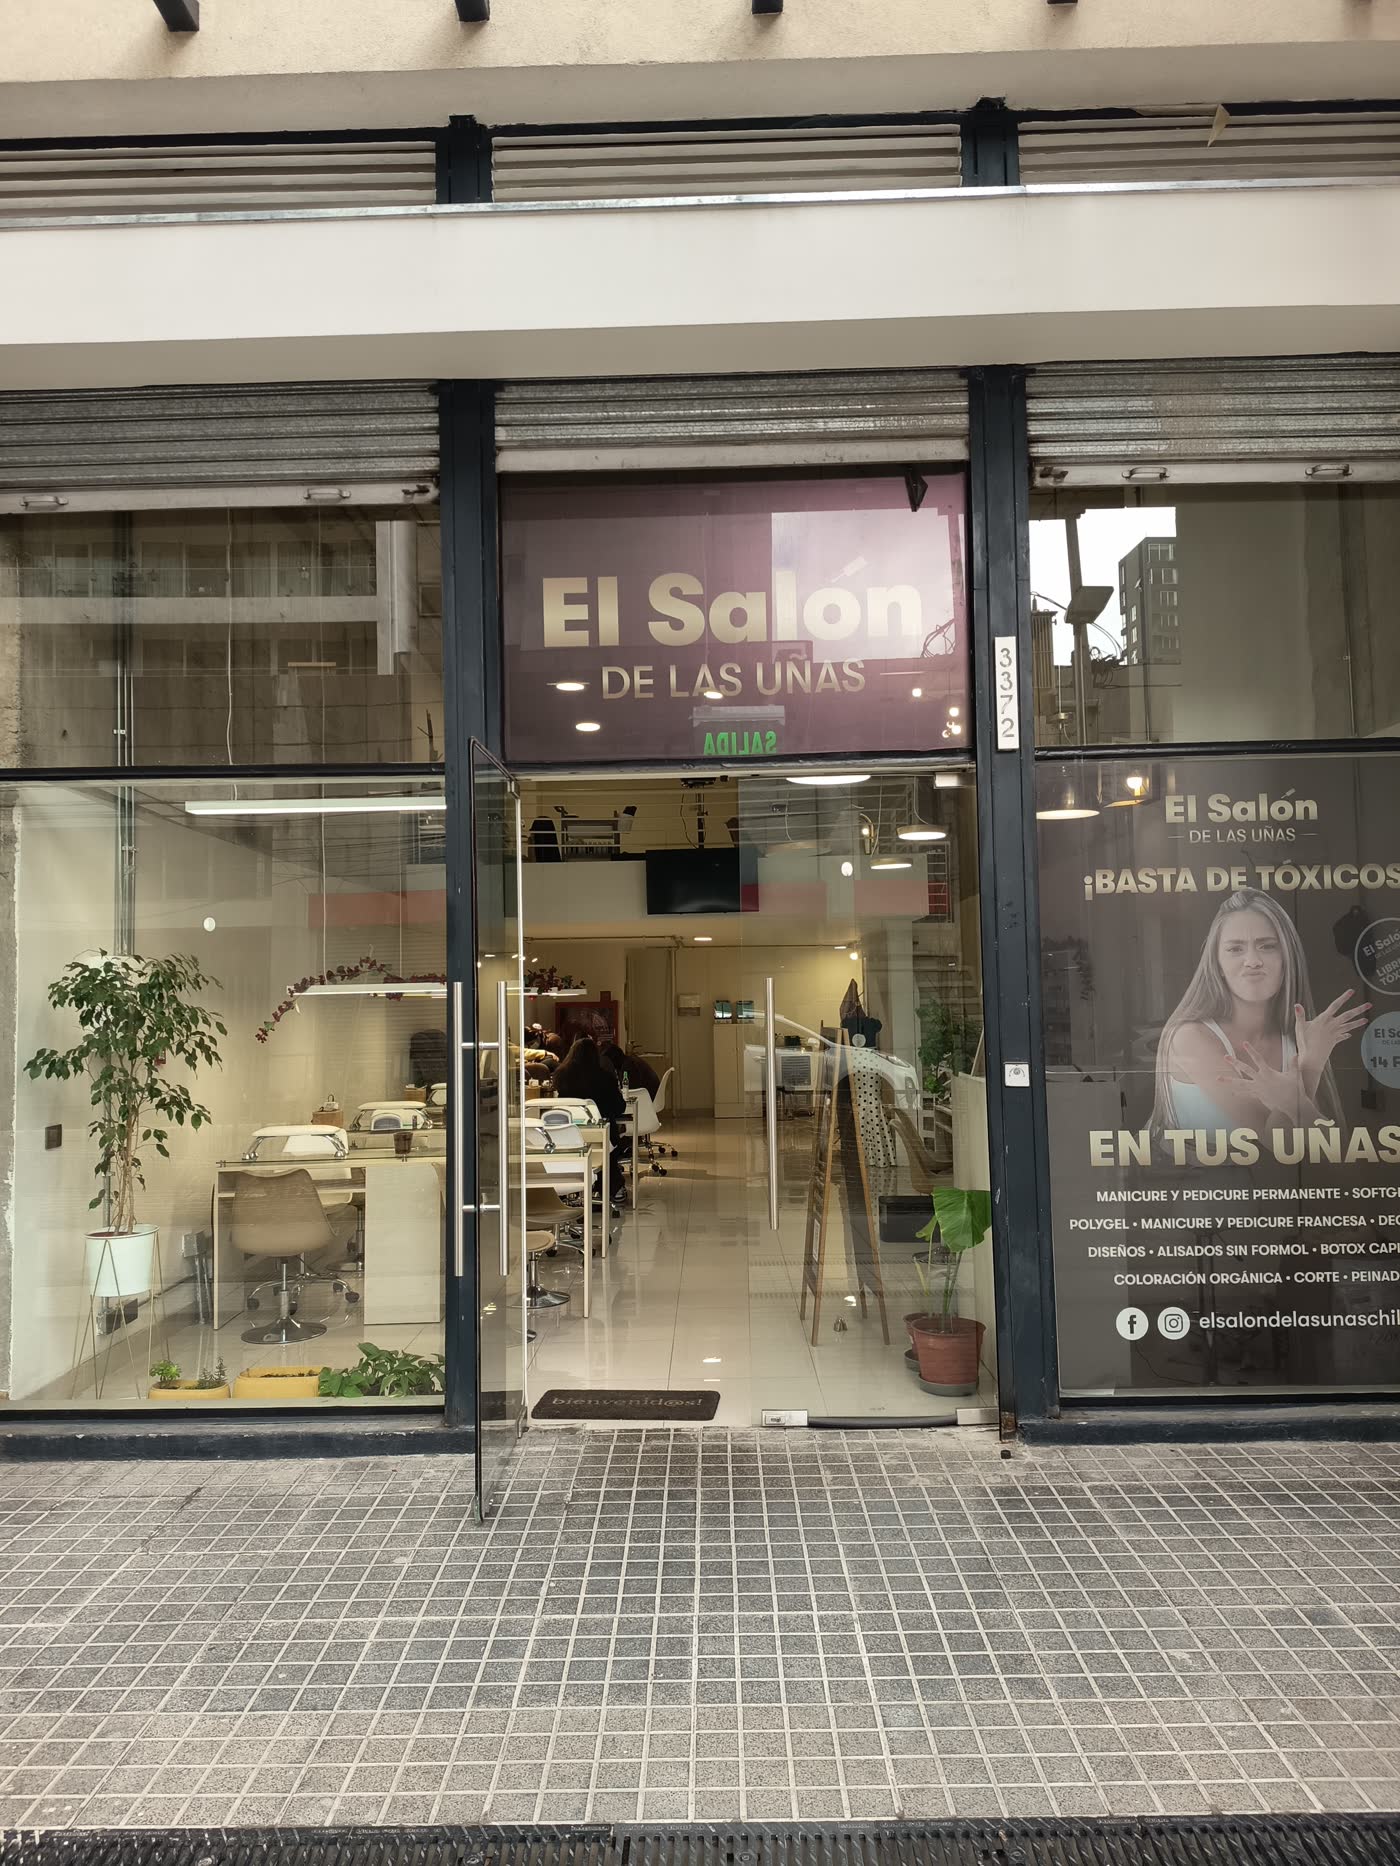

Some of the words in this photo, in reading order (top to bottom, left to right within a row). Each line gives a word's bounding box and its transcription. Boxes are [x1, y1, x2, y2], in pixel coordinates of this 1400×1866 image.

[543, 576, 620, 648] El
[648, 556, 923, 647] Salón
[602, 665, 655, 700] DE
[670, 662, 743, 698] LAS
[756, 653, 866, 697] UÑAS
[999, 647, 1016, 738] 3372
[1166, 794, 1197, 823] El
[1207, 788, 1319, 823] Salón
[1189, 830, 1211, 844] DE
[1217, 828, 1247, 843] LAS
[1252, 825, 1296, 842] UÑAS
[1084, 867, 1198, 900] ¡BASTA
[1206, 867, 1248, 892] DE
[1256, 859, 1400, 891] TÓXICOS
[1375, 928, 1400, 950] Saló
[1370, 1056, 1388, 1068] 14
[1089, 1129, 1152, 1167] EN
[1164, 1127, 1260, 1166] TUS
[1272, 1118, 1400, 1165] UÑAS
[1096, 1190, 1168, 1202] MANICURE
[1170, 1190, 1180, 1201] Y
[1183, 1189, 1249, 1201] PEDICURE
[1253, 1188, 1341, 1200] PERMANENTE
[1069, 1218, 1130, 1230] POLYGEL
[1141, 1217, 1212, 1229] MANICURE
[1215, 1217, 1224, 1228] Y
[1228, 1216, 1293, 1228] PEDICURE
[1297, 1215, 1367, 1227] FRANCESA
[1088, 1243, 1146, 1258] DISEÑOS
[1157, 1245, 1224, 1257] ALISADOS
[1226, 1245, 1248, 1256] SIN
[1251, 1244, 1309, 1256] FORMOL
[1320, 1243, 1366, 1255] BOTOX
[1113, 1271, 1206, 1285] COLORACIÓN
[1209, 1270, 1283, 1284] ORGÁNICA
[1294, 1271, 1340, 1283] CORTE
[1351, 1270, 1400, 1282] PEINAD
[1199, 1308, 1400, 1329] elsalondelasunaschil
